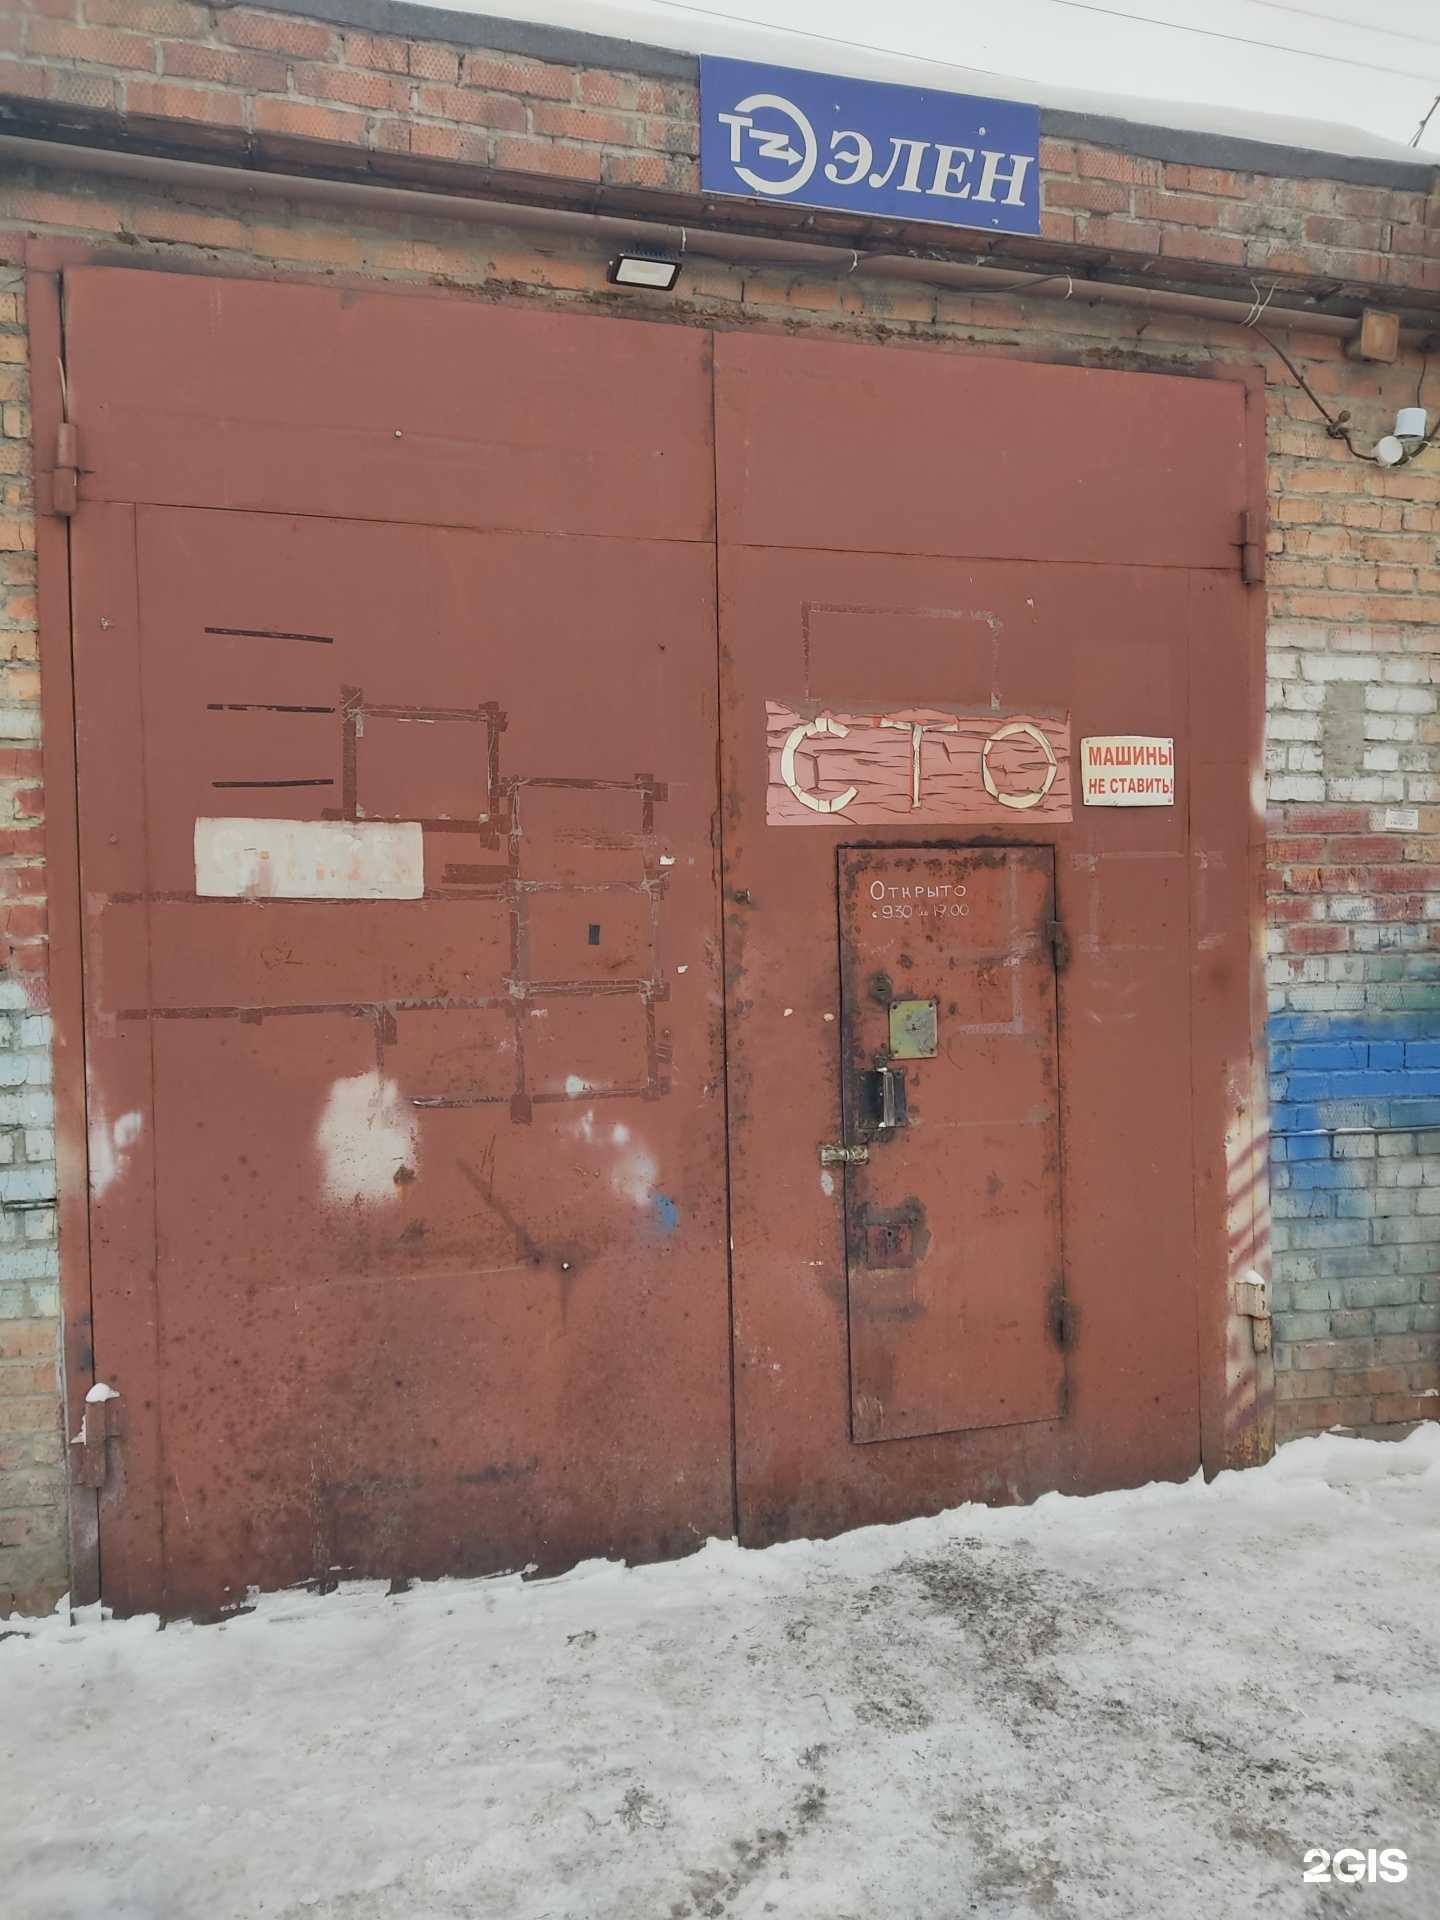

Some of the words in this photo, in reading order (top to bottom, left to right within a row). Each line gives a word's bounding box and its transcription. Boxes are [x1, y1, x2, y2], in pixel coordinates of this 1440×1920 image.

[824, 129, 1035, 207] ЭЛЕН
[781, 717, 1057, 813] СТО
[1088, 746, 1172, 766] МАШИНЫ
[1088, 778, 1105, 794] НЕ
[1110, 778, 1173, 794] СТАВИТЬ!
